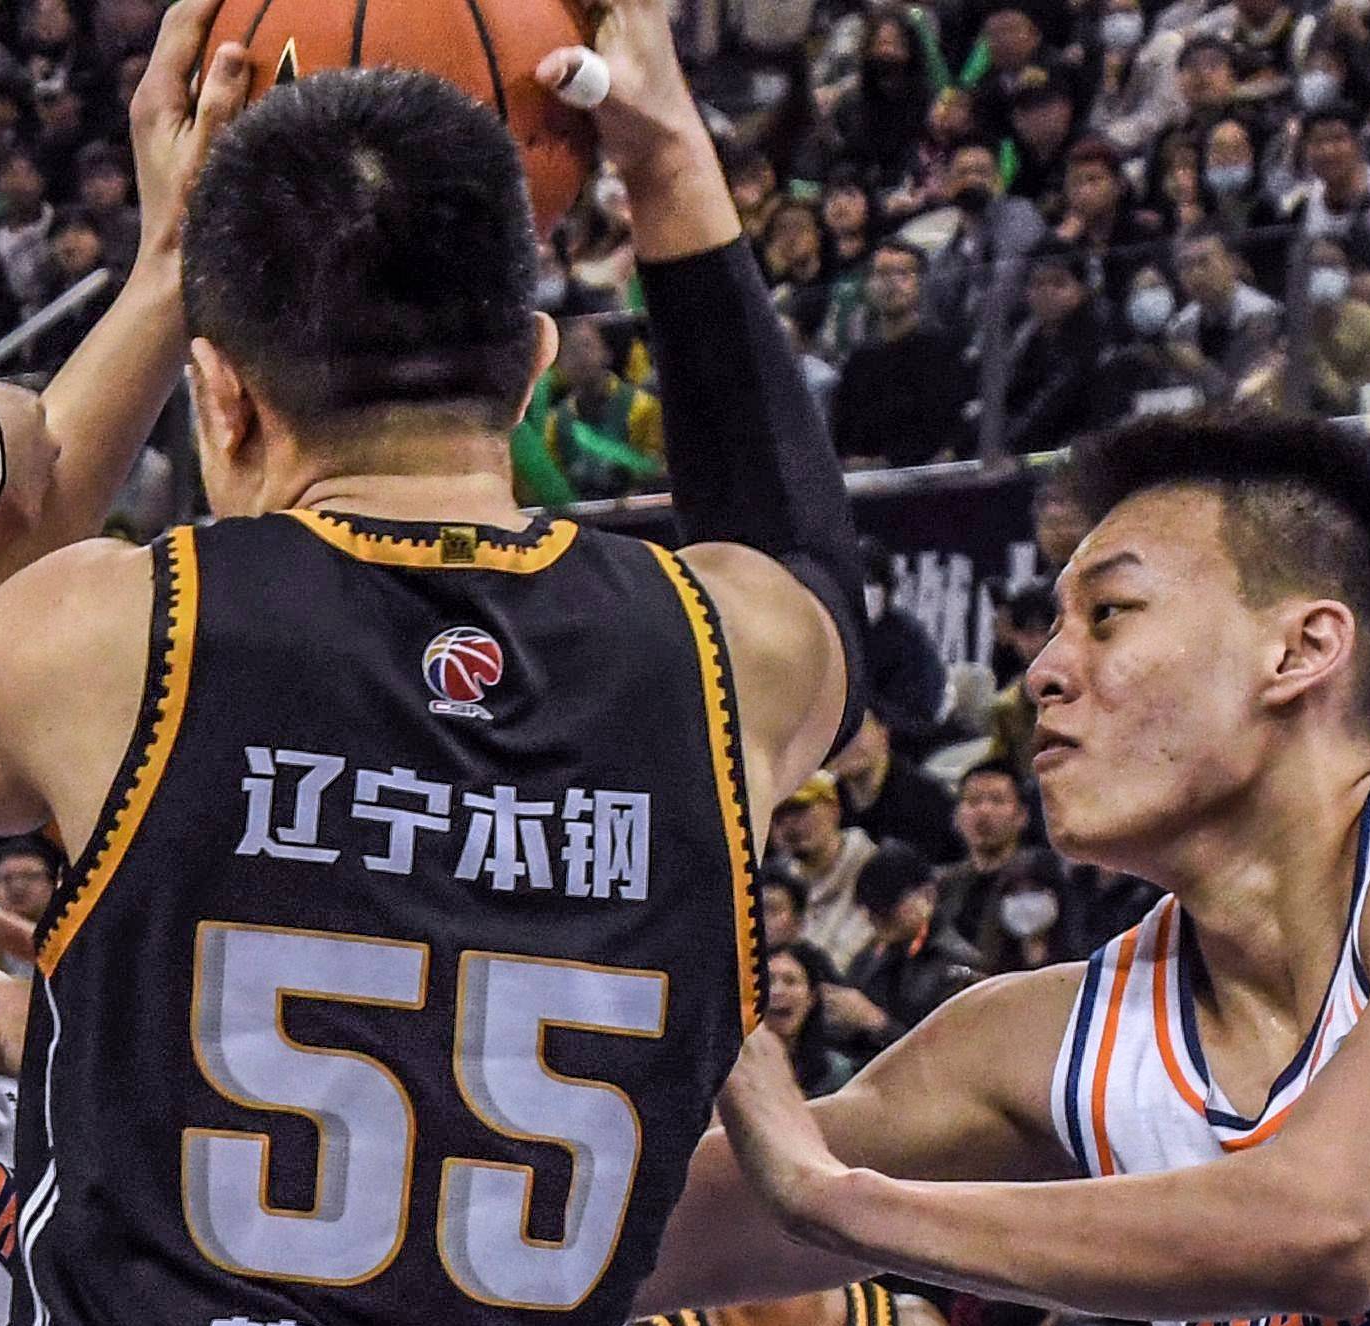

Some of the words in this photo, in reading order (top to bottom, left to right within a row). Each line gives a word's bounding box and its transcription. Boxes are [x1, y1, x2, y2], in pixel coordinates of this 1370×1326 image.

[234, 746, 651, 900] 辽宁本钢
[182, 919, 668, 1311] 55
